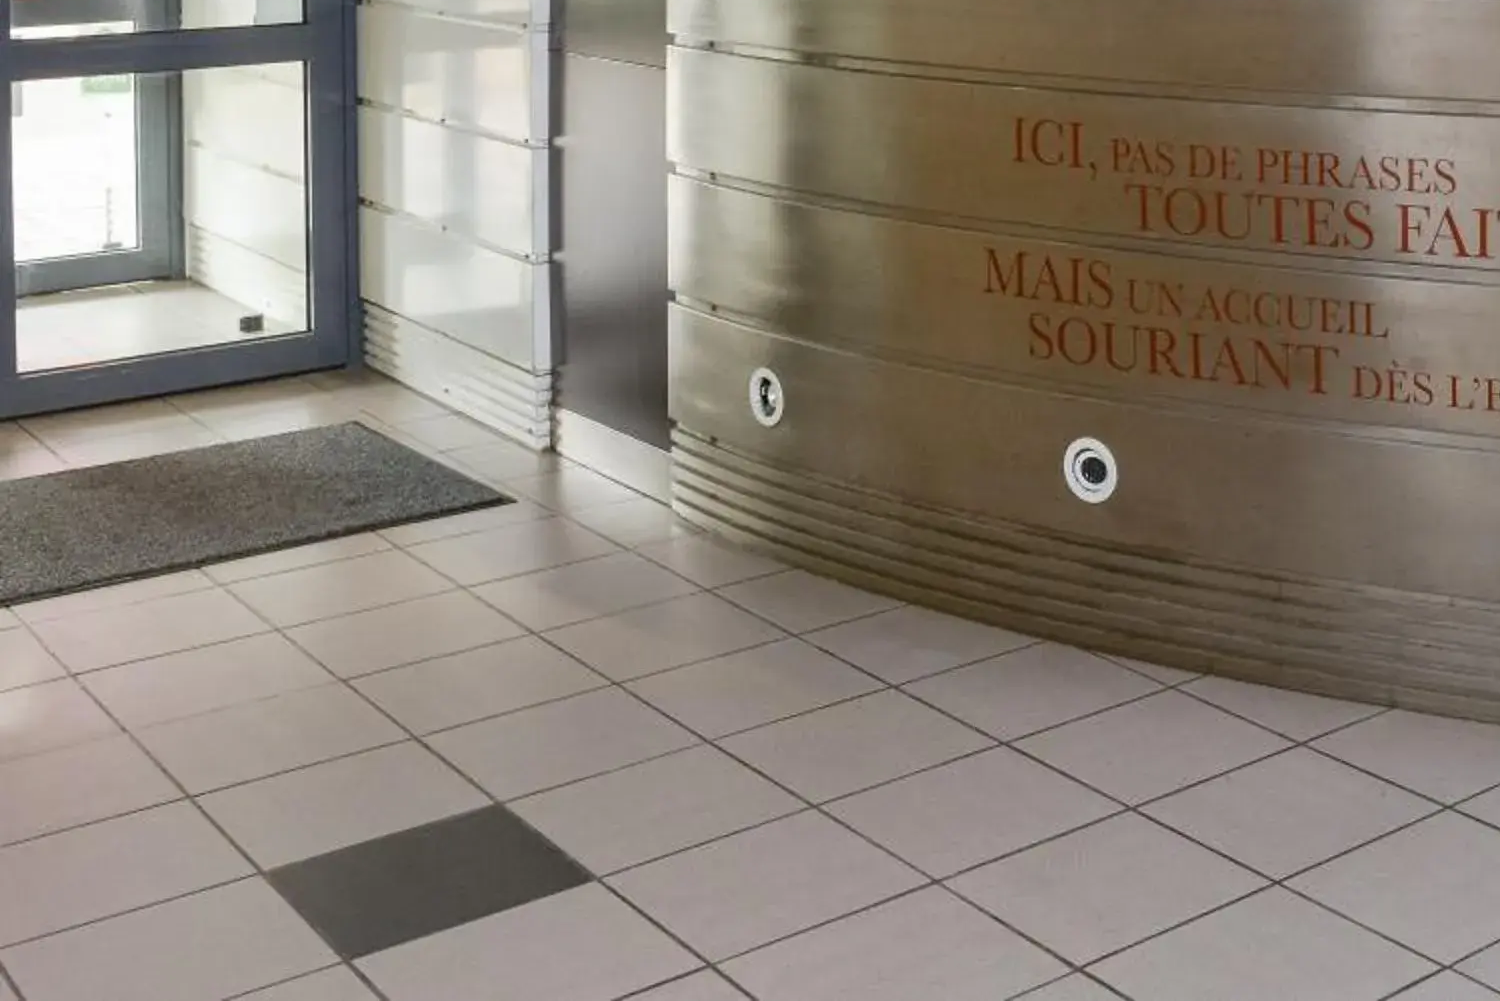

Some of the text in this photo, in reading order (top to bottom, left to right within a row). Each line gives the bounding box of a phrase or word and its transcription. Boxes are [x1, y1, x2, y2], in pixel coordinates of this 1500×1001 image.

[1012, 116, 1457, 195] ICI, PAS DE PHRASES
[1124, 184, 1375, 250] TOUTES
[983, 246, 1389, 338] MAIS UN ACCUEIL
[1029, 312, 1340, 394] SOURIANT
[1353, 359, 1434, 406] DÈS
